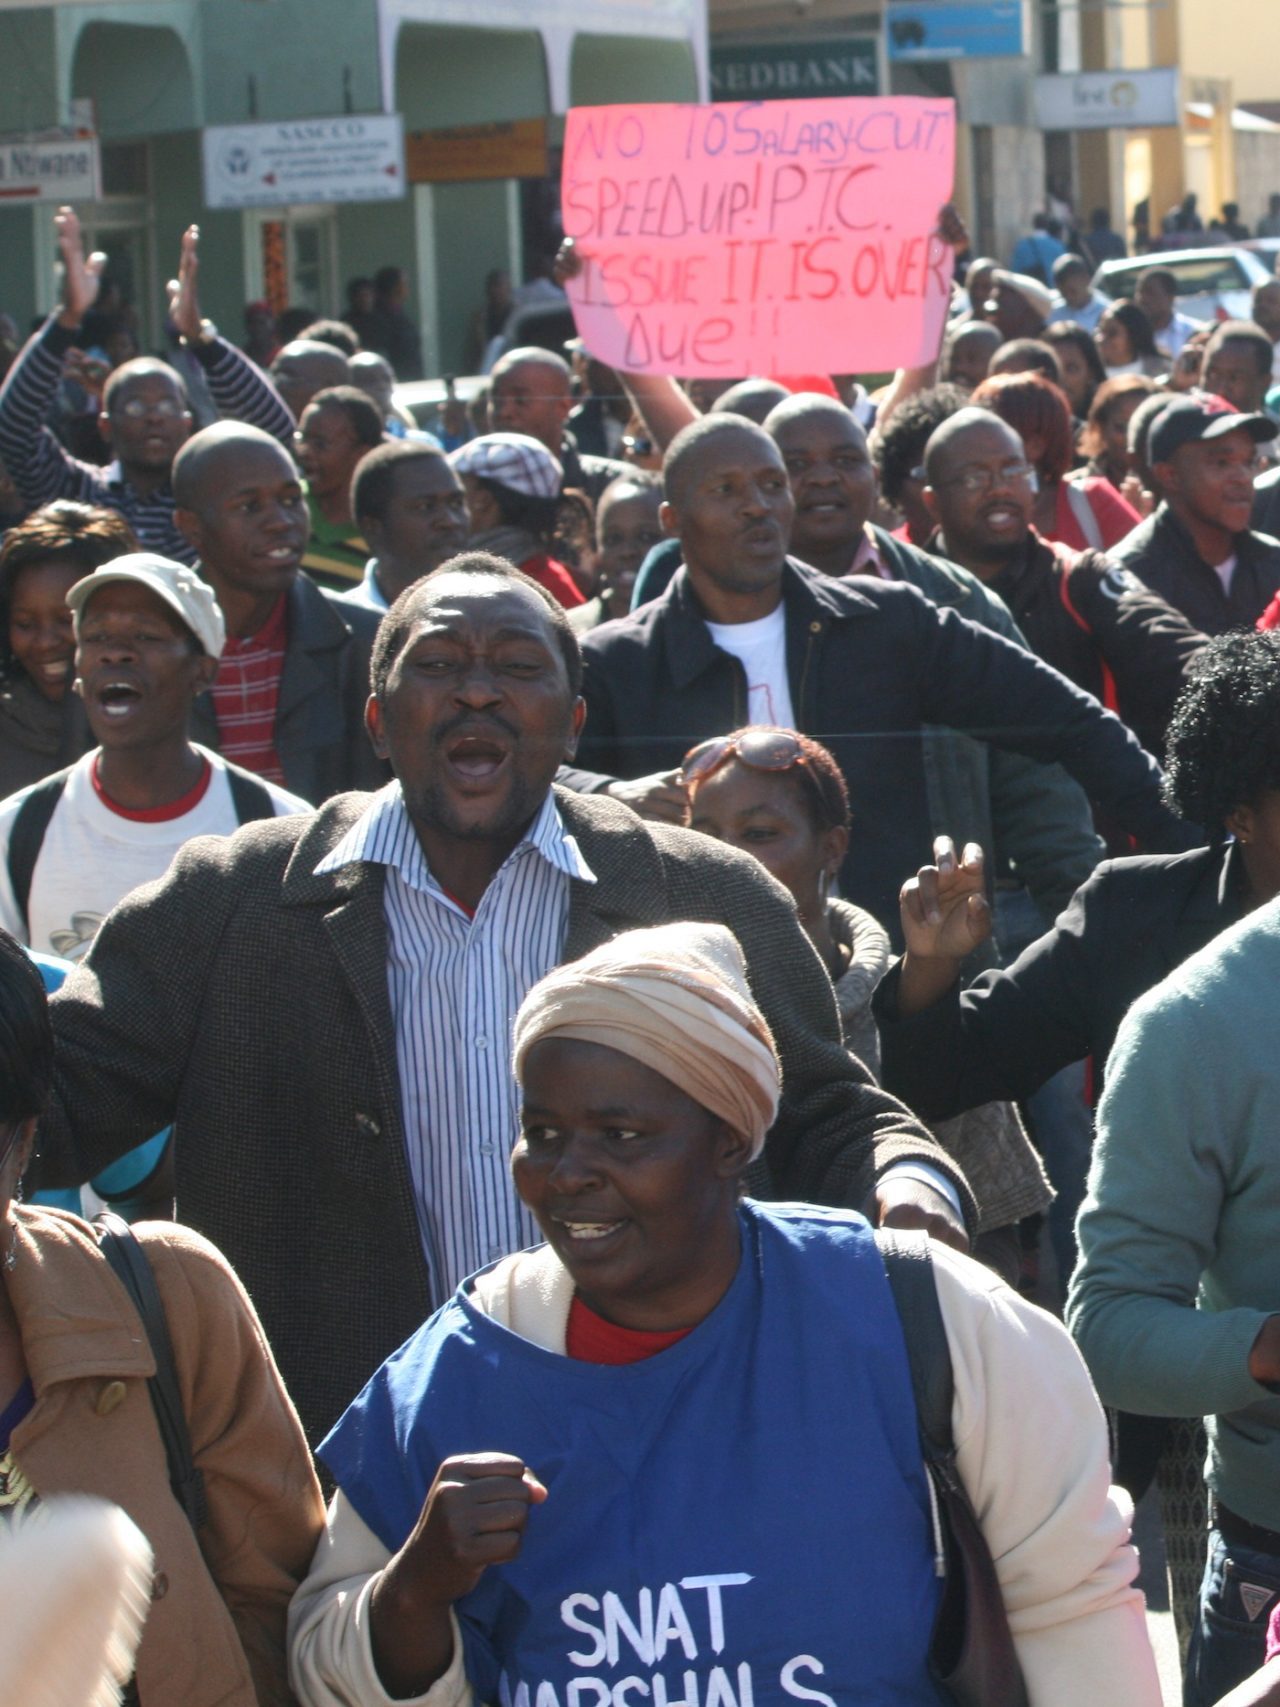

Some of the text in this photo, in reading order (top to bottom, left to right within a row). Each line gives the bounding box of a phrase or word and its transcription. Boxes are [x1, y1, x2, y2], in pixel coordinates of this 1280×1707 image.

[573, 112, 644, 160] NO
[576, 252, 707, 309] ISSUE
[852, 233, 948, 302] OVER
[560, 1572, 757, 1668] SNAT
